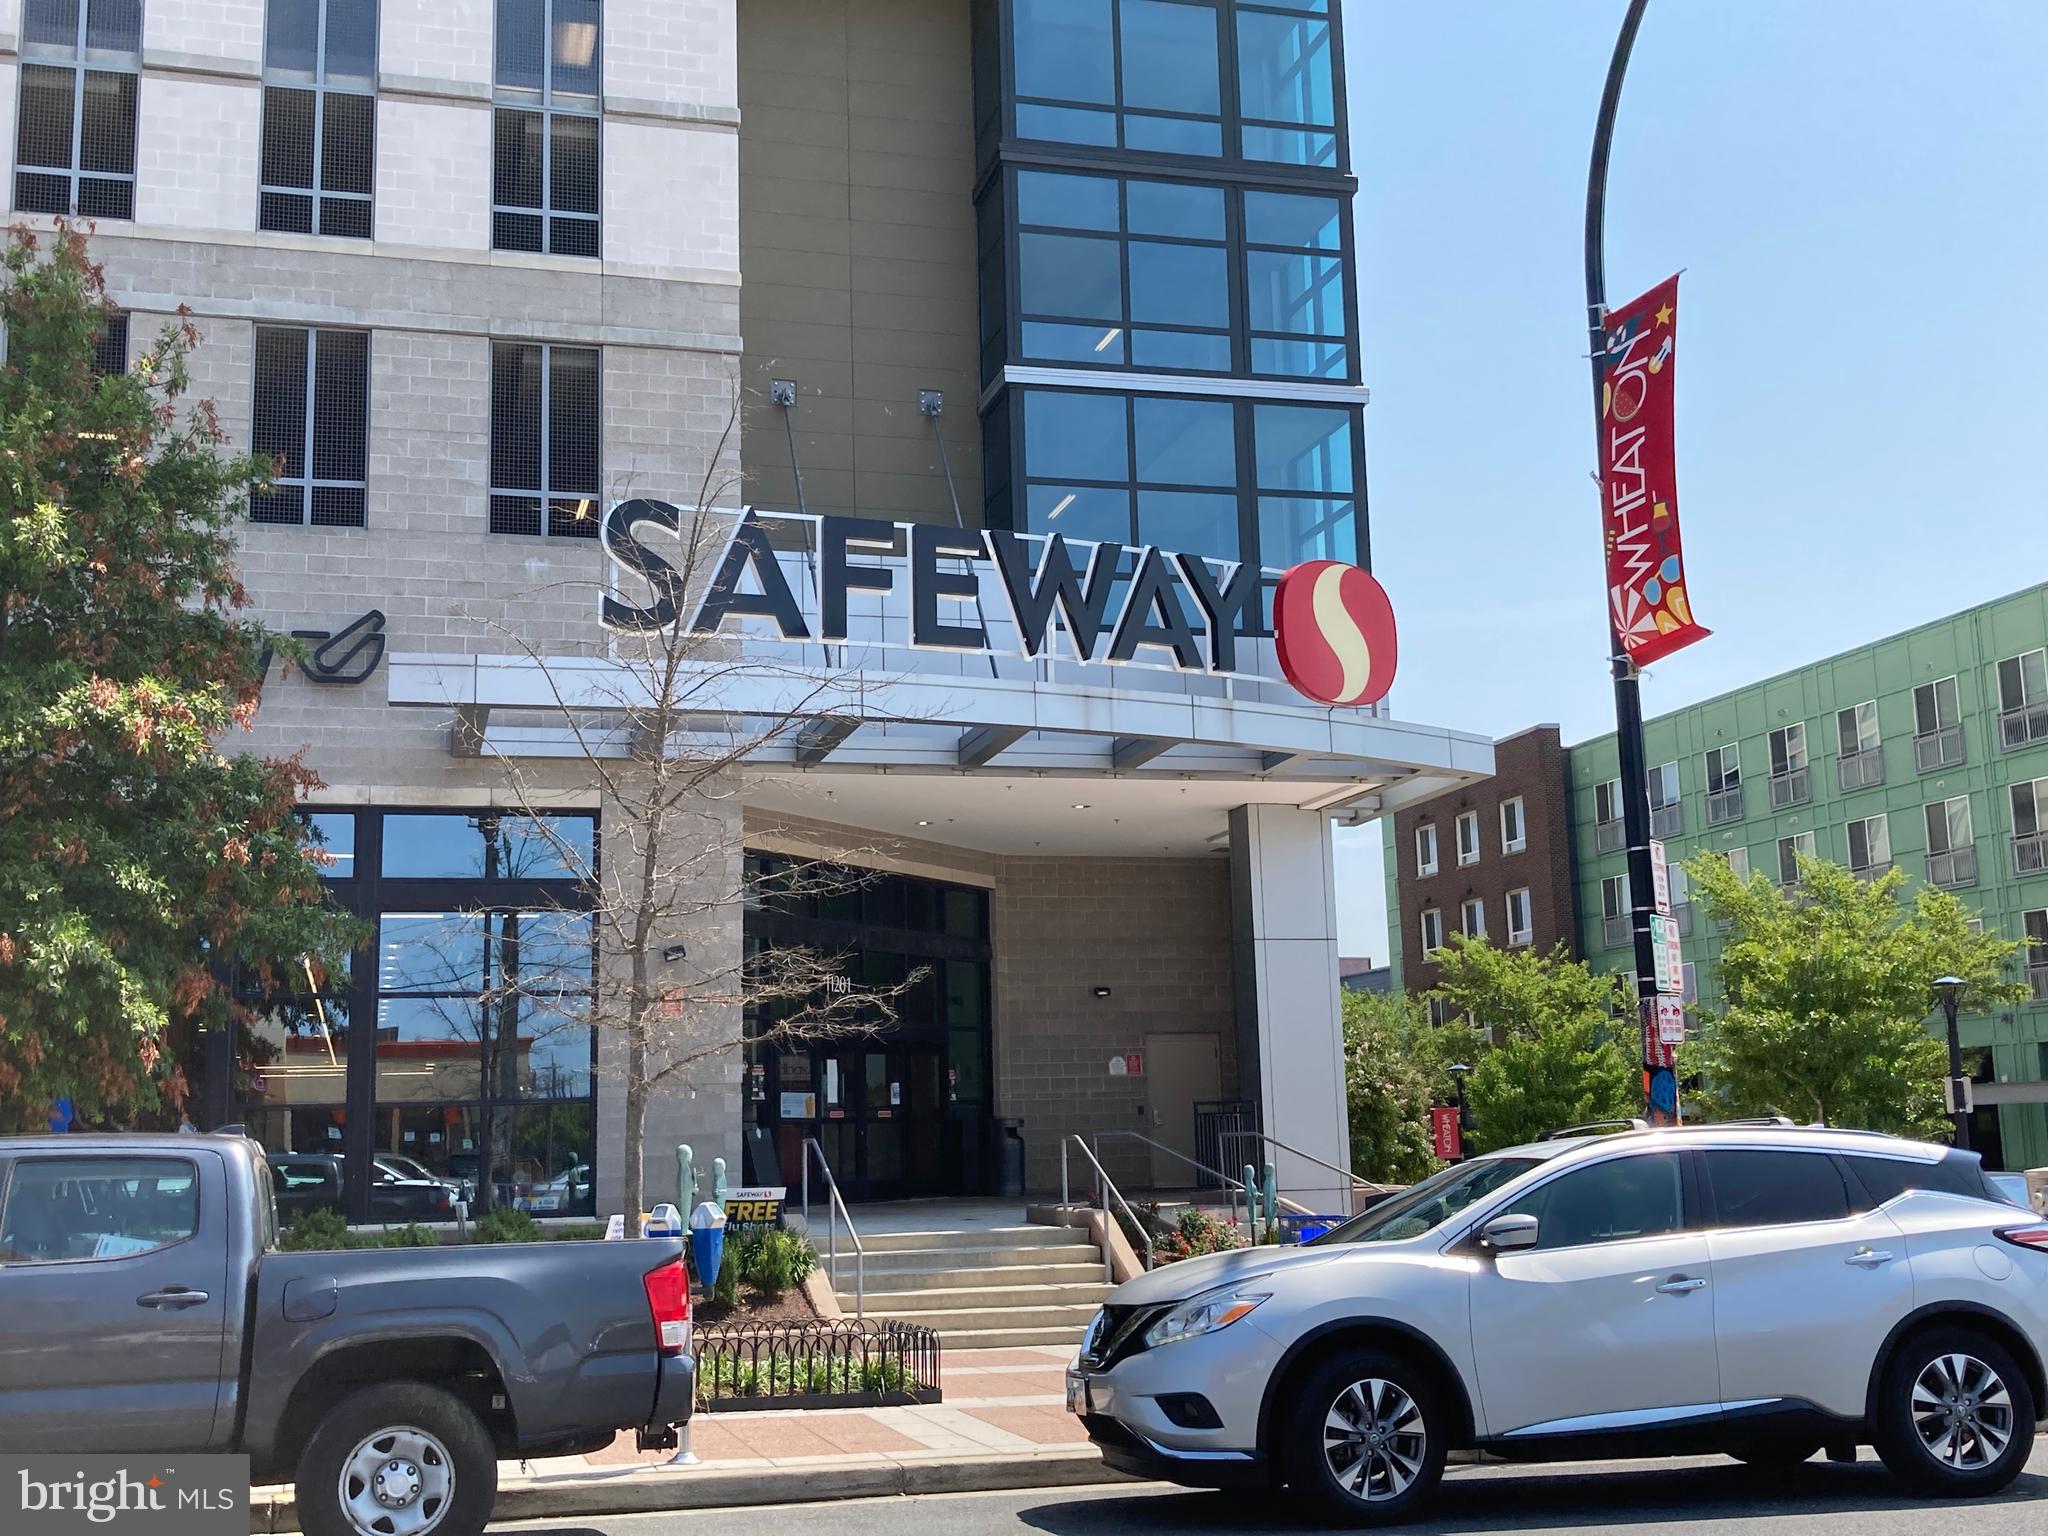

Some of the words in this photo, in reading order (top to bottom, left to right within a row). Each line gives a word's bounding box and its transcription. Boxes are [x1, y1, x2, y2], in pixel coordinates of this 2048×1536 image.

[1611, 325, 1654, 590] WHEATON
[598, 498, 1262, 676] SAFEWAY
[825, 975, 851, 994] 11201
[1441, 1113, 1453, 1153] WHEATON
[724, 1201, 780, 1221] FREE
